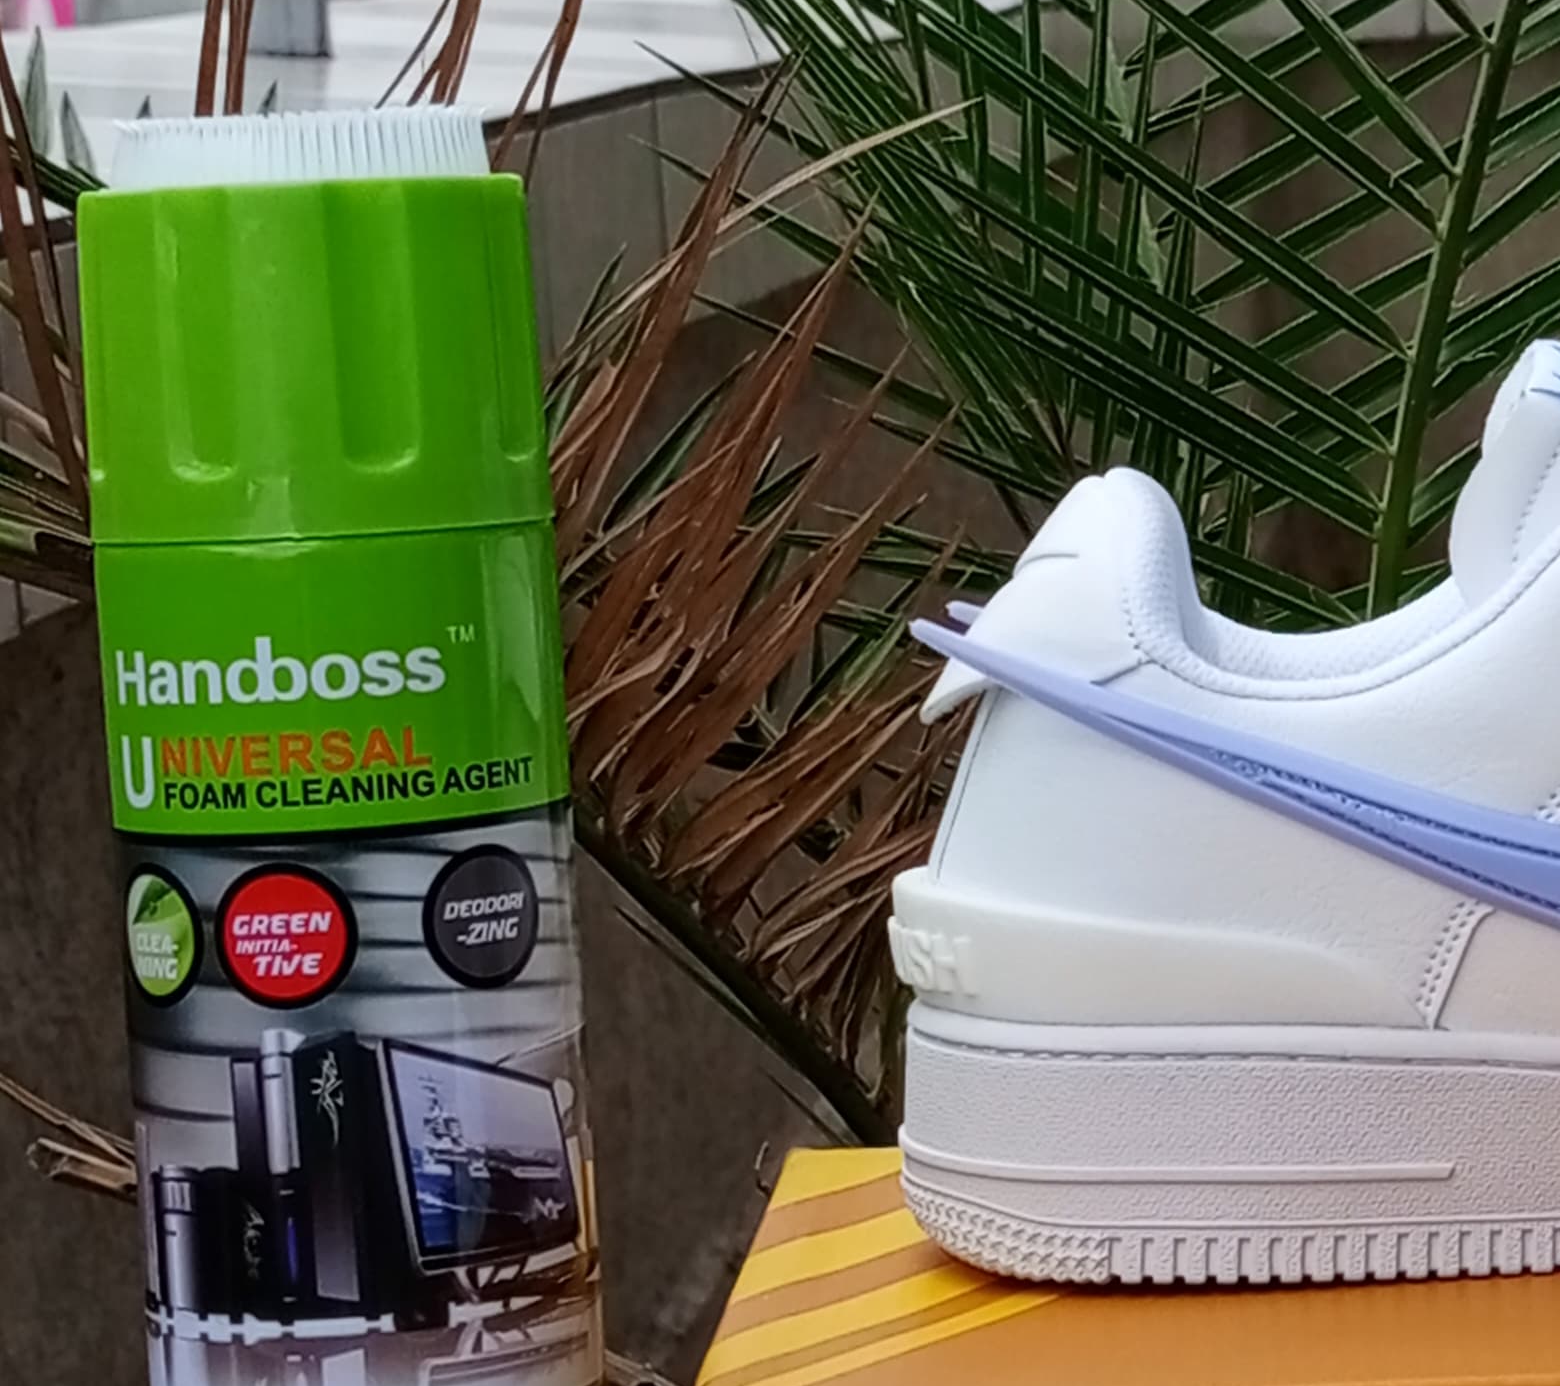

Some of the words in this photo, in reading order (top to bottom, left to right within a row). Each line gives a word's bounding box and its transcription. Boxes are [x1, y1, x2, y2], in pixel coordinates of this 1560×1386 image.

[115, 635, 447, 707] Handboss
[163, 780, 248, 810] FOAM
[255, 769, 435, 809] CLEANING
[442, 756, 533, 796] AGENT
[443, 890, 524, 921] DEODORI
[232, 911, 332, 936] GREEN
[235, 938, 298, 955] INITIA-
[253, 952, 323, 977] TIVE
